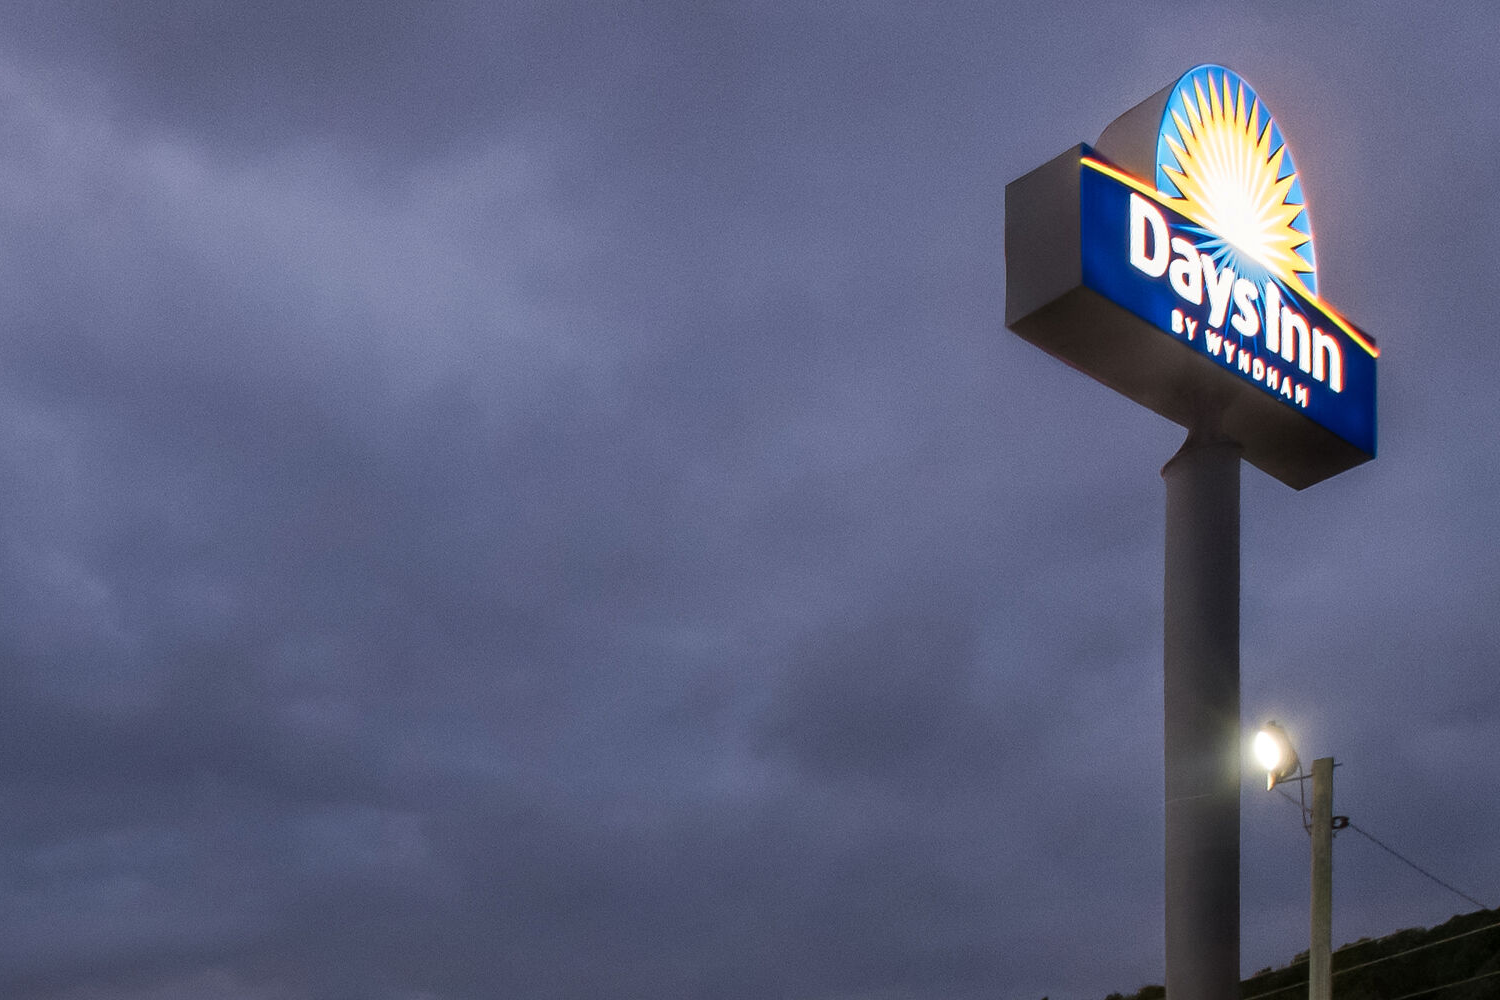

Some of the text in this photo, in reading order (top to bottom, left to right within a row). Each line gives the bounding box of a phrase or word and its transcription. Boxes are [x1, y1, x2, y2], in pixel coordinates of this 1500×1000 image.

[1130, 192, 1343, 393] Days Inn
[1171, 309, 1309, 408] BY WYNDHAM
